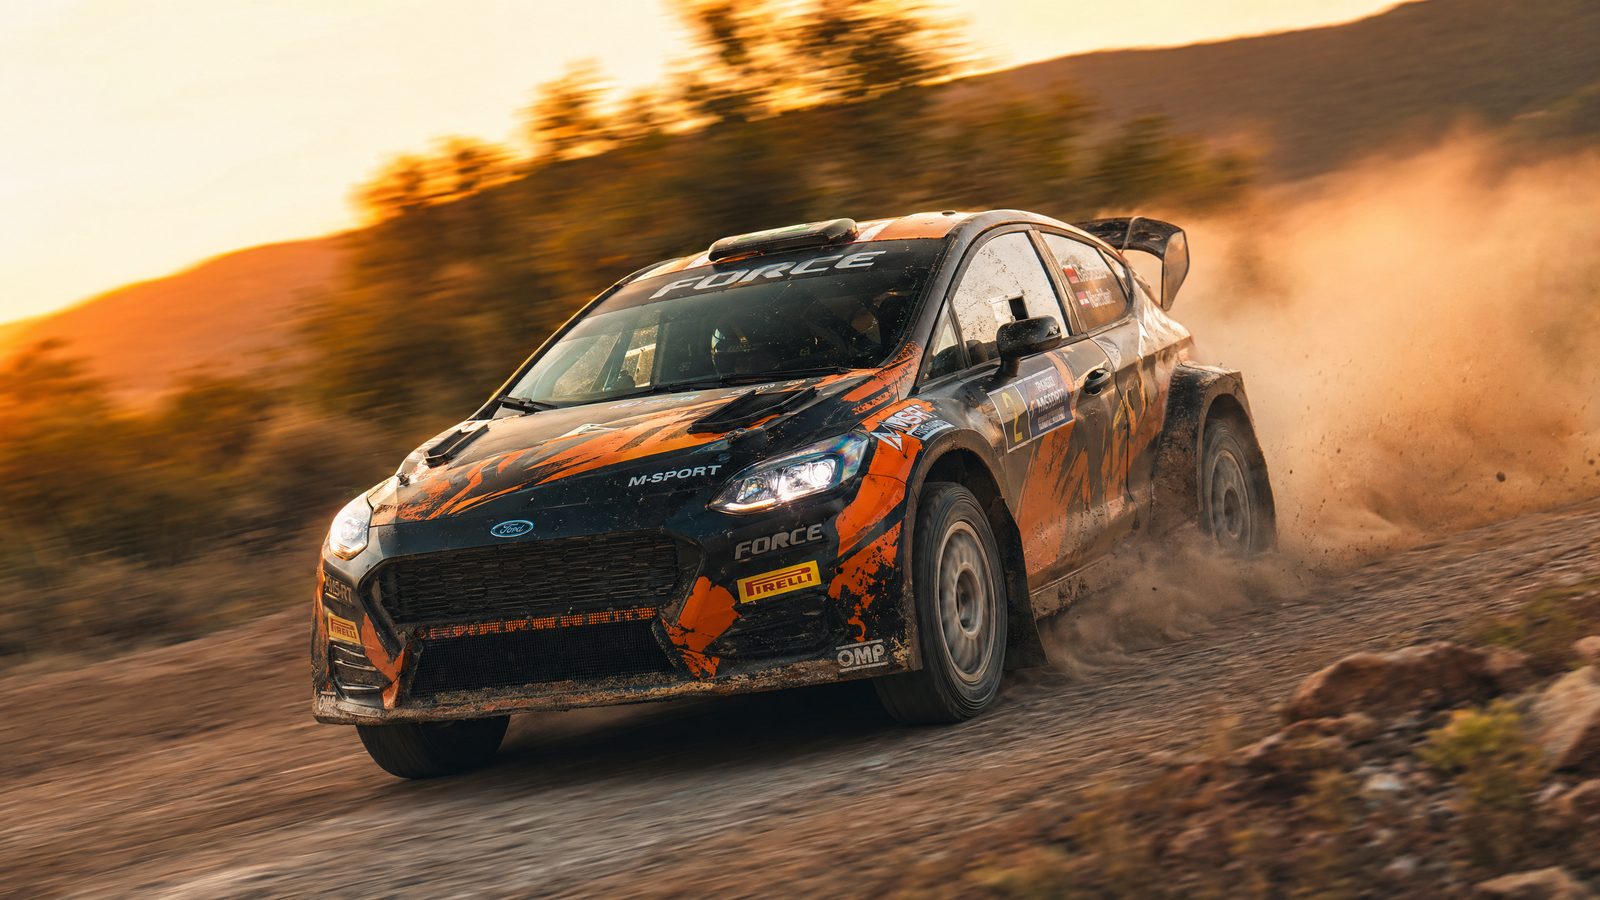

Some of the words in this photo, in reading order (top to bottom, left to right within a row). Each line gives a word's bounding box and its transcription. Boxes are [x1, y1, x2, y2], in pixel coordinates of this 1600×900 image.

[649, 250, 887, 300] FORCE
[1001, 392, 1023, 443] 2
[628, 465, 722, 487] M-SPORT
[735, 523, 823, 560] FORCE
[745, 566, 813, 597] PIRELLI
[837, 644, 885, 667] OMP
